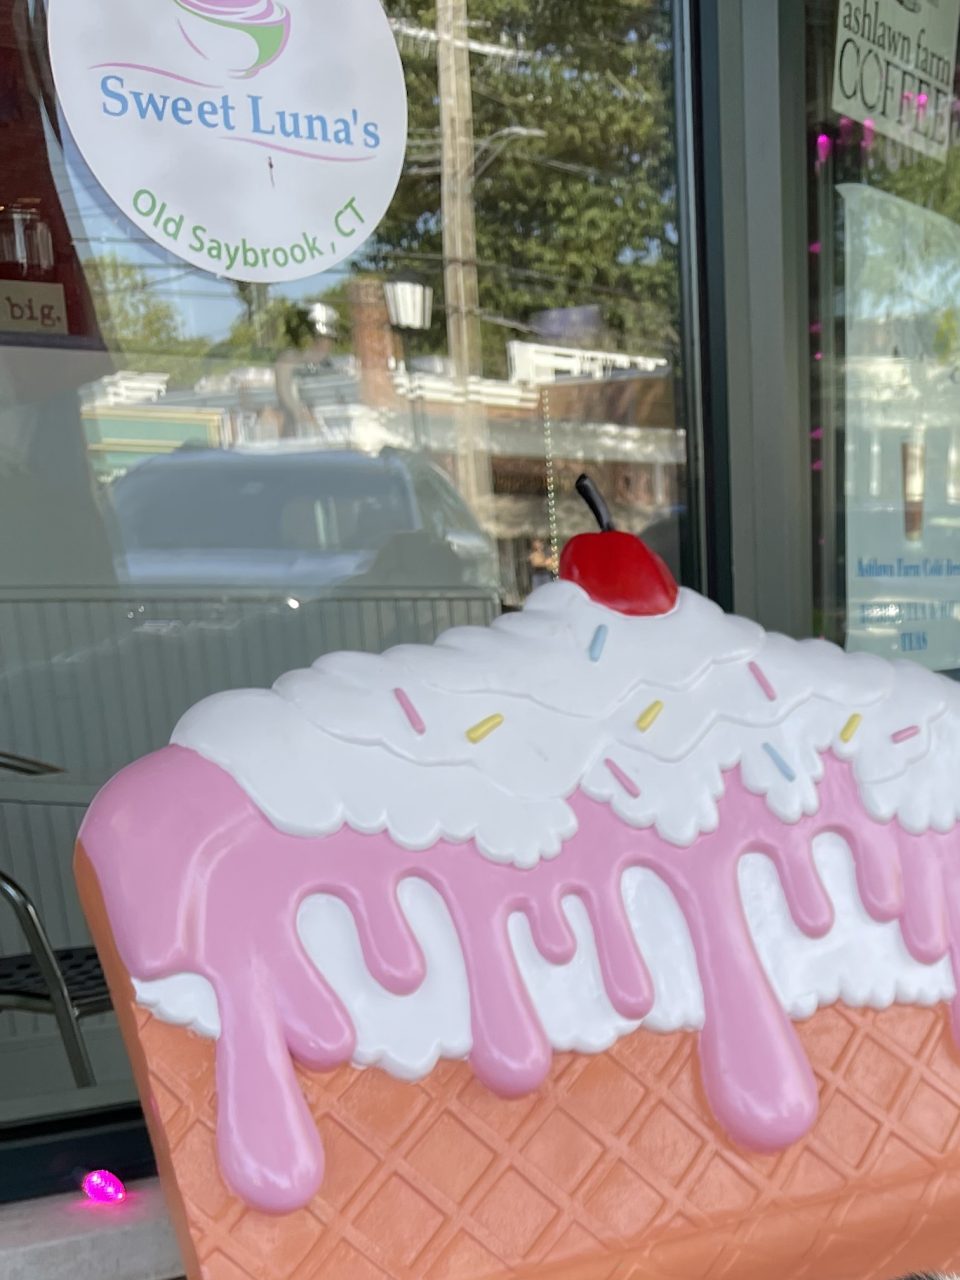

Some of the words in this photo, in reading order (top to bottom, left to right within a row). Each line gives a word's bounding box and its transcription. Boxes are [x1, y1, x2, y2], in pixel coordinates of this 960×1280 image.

[843, 0, 911, 64] ashlawn
[915, 28, 951, 86] farm
[100, 75, 235, 131] Sweet
[246, 94, 380, 148] Luna's
[840, 38, 949, 146] COFFEE
[132, 188, 184, 240] Old
[333, 197, 365, 237] CT
[4, 295, 62, 328] big.
